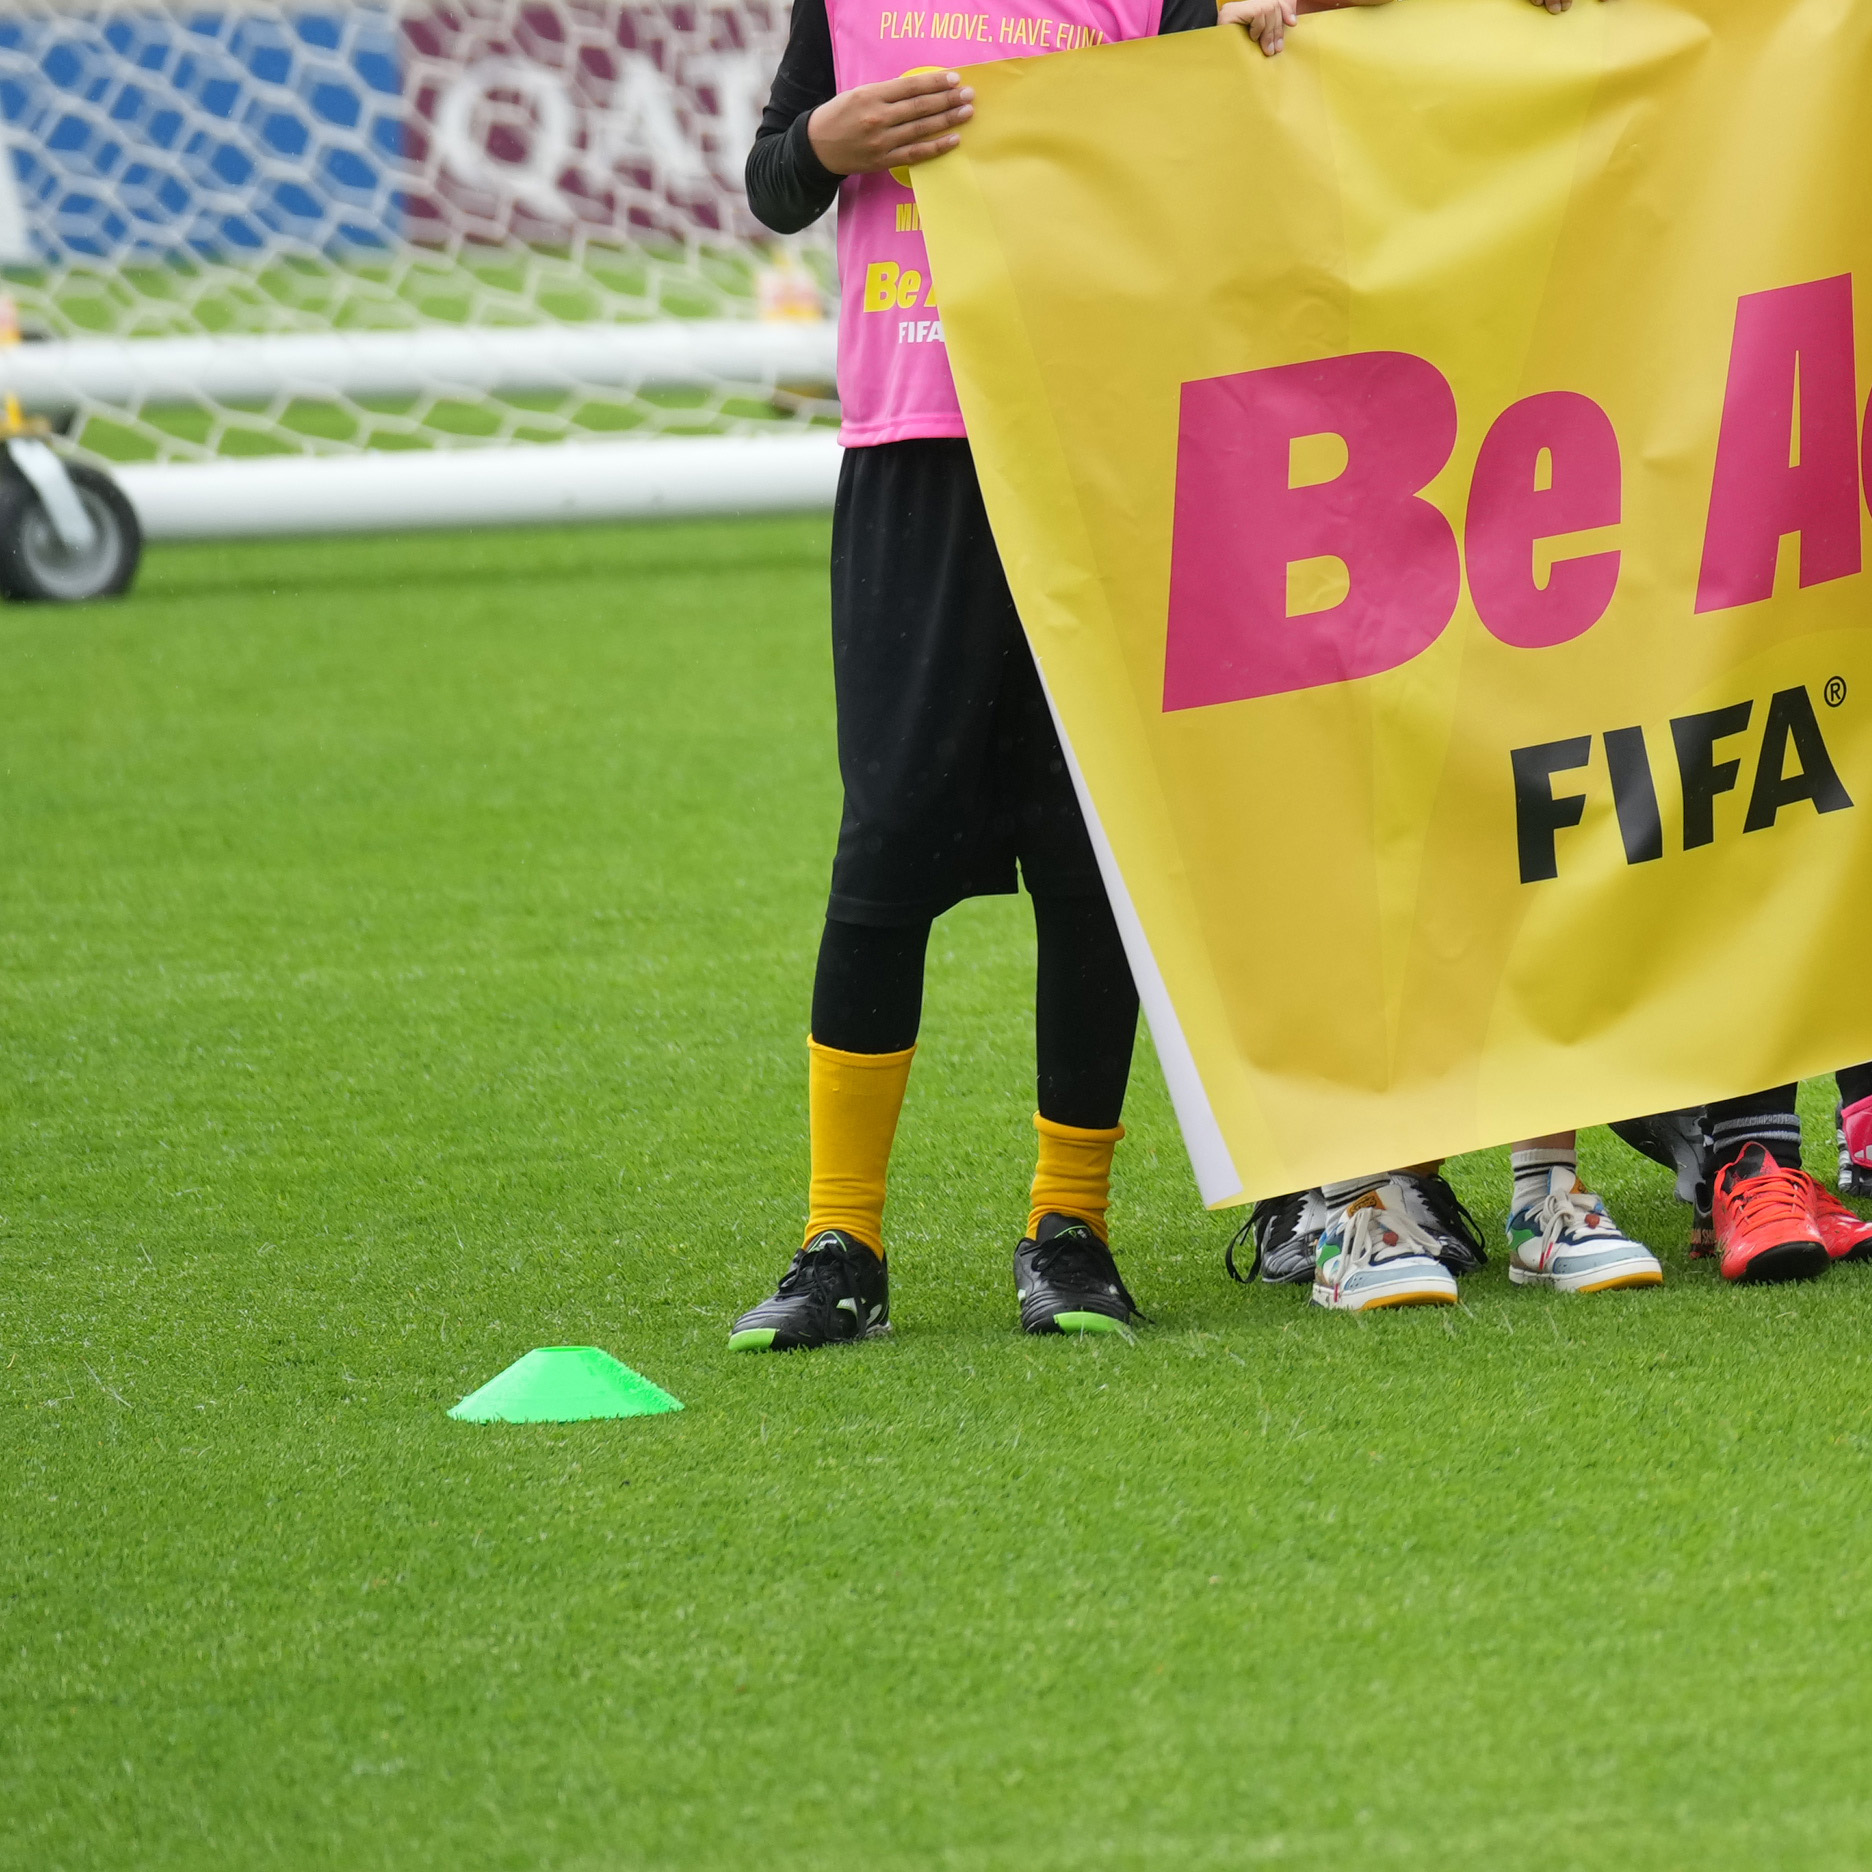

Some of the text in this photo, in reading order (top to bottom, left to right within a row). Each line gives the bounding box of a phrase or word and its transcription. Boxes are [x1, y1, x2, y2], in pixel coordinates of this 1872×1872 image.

[880, 11, 925, 39] PLAY.
[930, 12, 993, 43] MOVE.
[999, 17, 1053, 47] HAVE
[863, 261, 922, 313] Be
[898, 320, 945, 344] FIFA
[1162, 350, 1622, 713] Be
